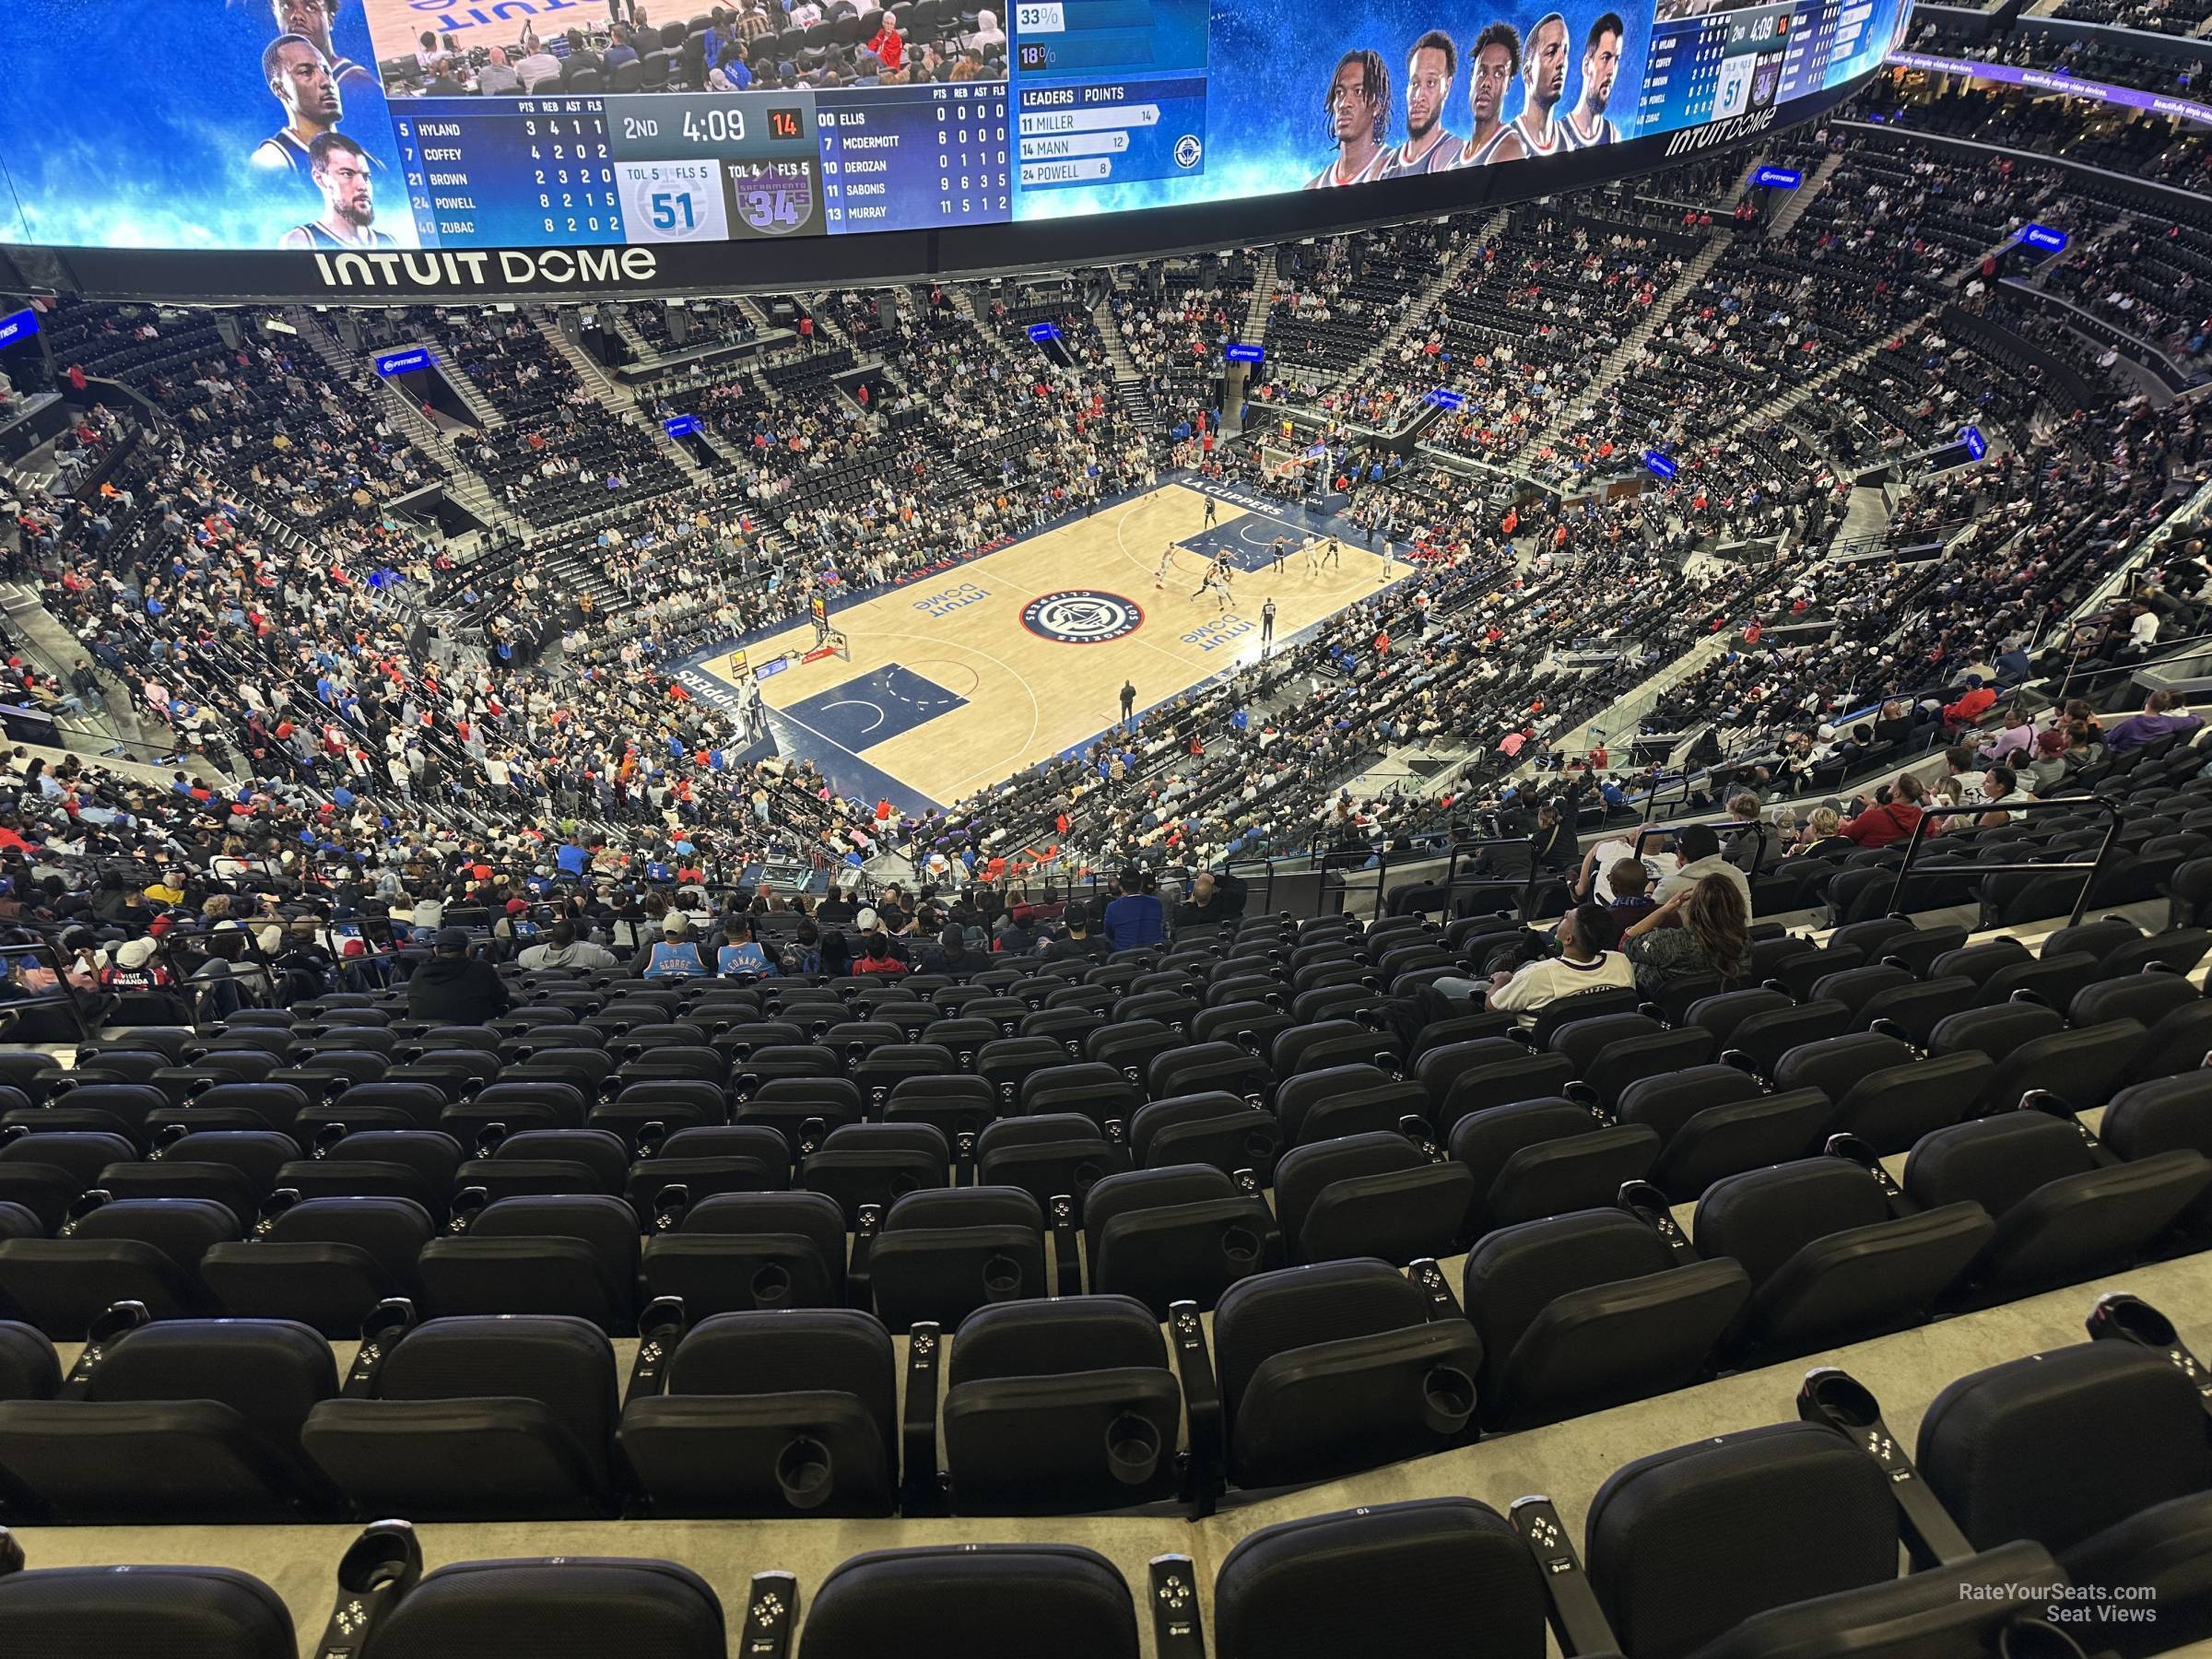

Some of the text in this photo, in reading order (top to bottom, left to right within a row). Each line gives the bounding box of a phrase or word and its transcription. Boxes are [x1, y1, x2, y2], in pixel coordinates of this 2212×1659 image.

[1021, 7, 1058, 25] 33%
[1731, 25, 1746, 43] 2ND
[1749, 15, 1774, 42] 4:09
[1021, 46, 1056, 64] 18%
[1651, 40, 1657, 53] 5
[1933, 59, 1949, 69] video
[933, 86, 1006, 100] PTS REB AST FLS
[1023, 87, 1124, 106] LEADERS POINTS
[1724, 77, 1742, 108] 51
[1753, 72, 1771, 101] 34
[519, 100, 603, 112] PTS REB AST FLS
[818, 104, 1005, 127] 00 ELLIS 0 0 0 0
[2153, 99, 2186, 114] Beautifully
[400, 120, 602, 136] 5 HYLAND 3 4 1 1
[623, 110, 797, 142] 2ND 4:09 14
[1022, 111, 1151, 132] 11 MILLER 14
[1665, 105, 1778, 157] INTUIT DOME
[824, 127, 1006, 150] 7 MCDERMOTT 6 0 0 0
[1022, 137, 1124, 156] 14 MANN 12
[406, 145, 607, 161] 7 COFFEY 4 2 0 2
[824, 151, 1006, 174] 10 DEROZAN 0 1 1 0
[408, 169, 611, 185] 21 BROWN 2 3 2 0
[628, 167, 708, 180] TOL 5 FLS 5
[728, 161, 810, 178] TOL 4 FLS 5
[1023, 163, 1106, 181] 24 POWELL 8
[739, 182, 806, 192] SACRAMENTO
[827, 173, 1006, 198] 11 SABONIS 9 6 3 5
[413, 193, 615, 209] 24 POWELL 8 2 1 5
[748, 190, 798, 227] 34
[828, 196, 1007, 220] 13 MURRAY 11 5 1 2
[651, 192, 696, 230] 51
[418, 218, 619, 234] 40 ZUBAC 8 2 0 2
[314, 246, 657, 286] INTUIT DOME
[394, 355, 423, 368] FITNESS
[1181, 477, 1284, 516] LA CLIPPERS
[912, 582, 978, 610] DOME
[928, 589, 993, 618] INTUIT
[1025, 591, 1091, 621] CLIPPERS
[1056, 604, 1139, 642] LOS ANGELES
[1180, 613, 1241, 643] DOME
[1198, 620, 1257, 652] INTUIT
[515, 926, 528, 935] 14
[659, 959, 693, 971] GEORGE
